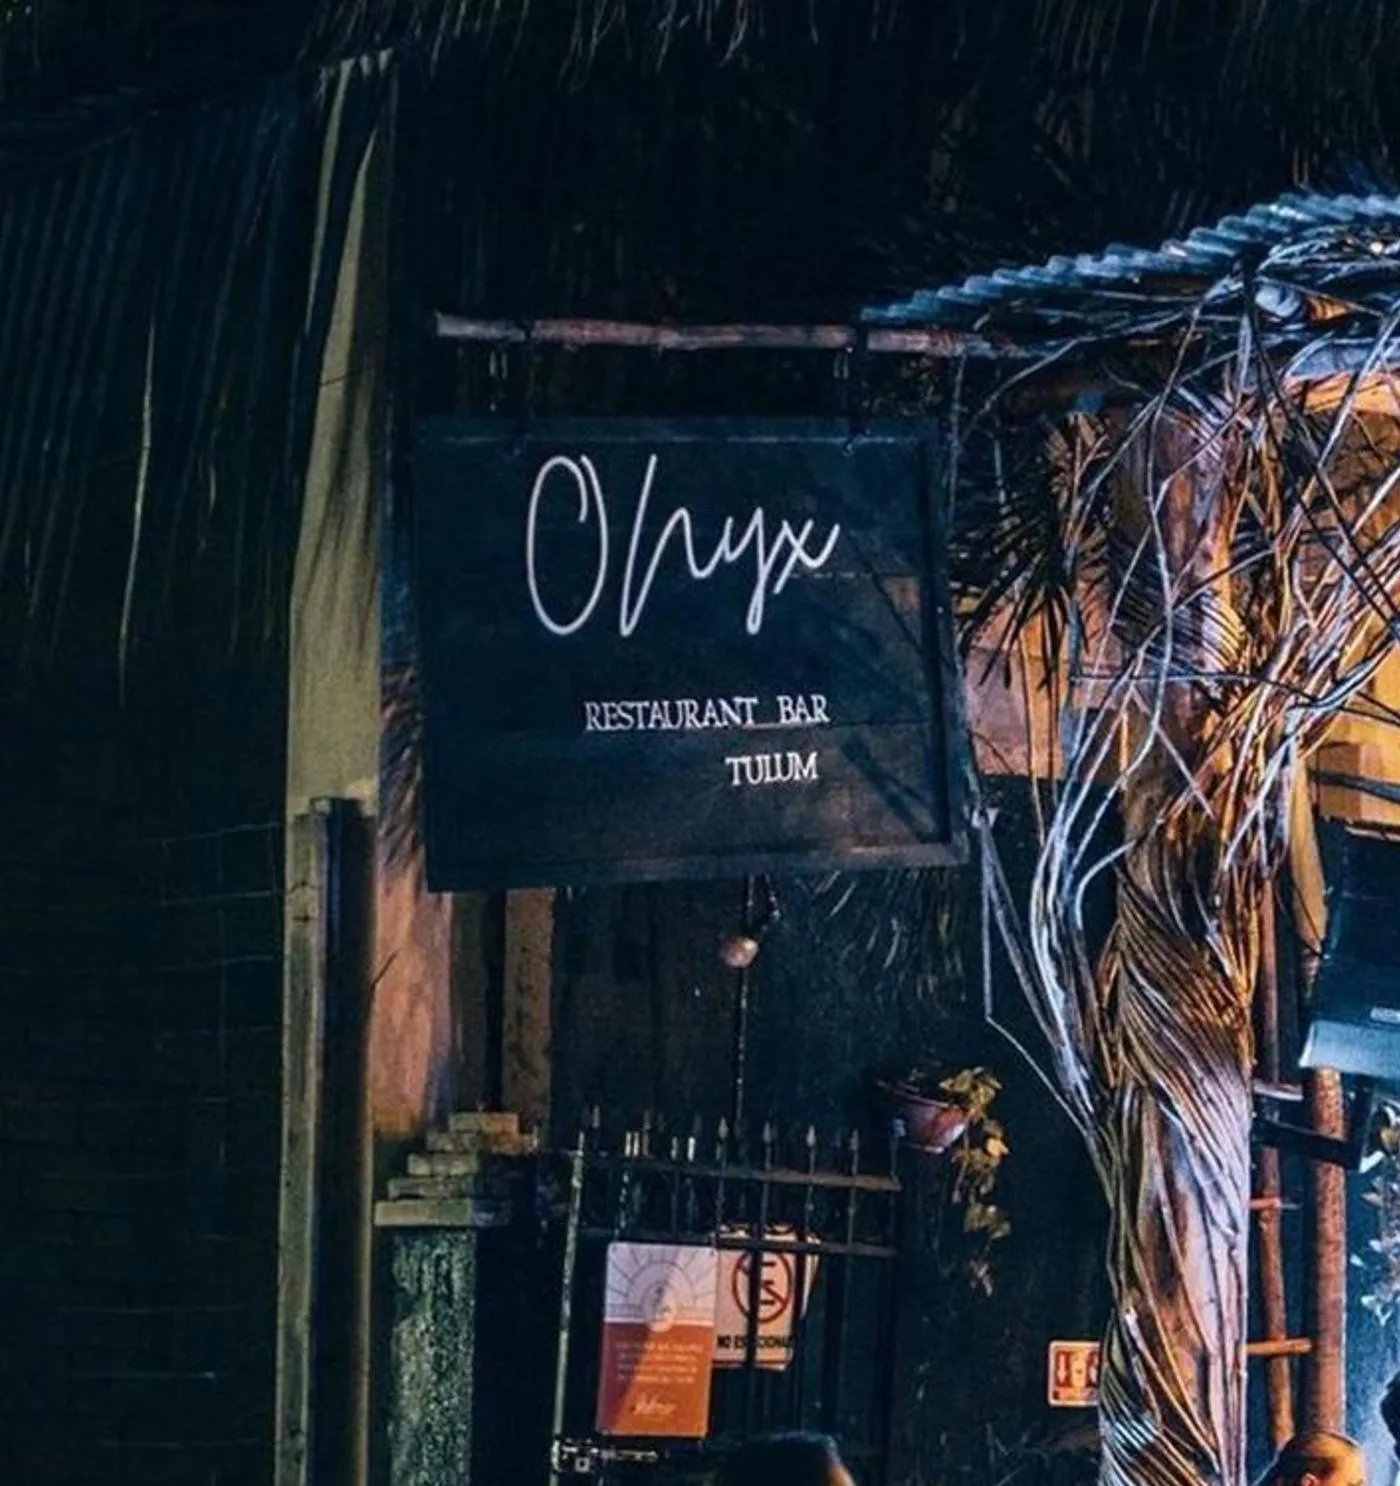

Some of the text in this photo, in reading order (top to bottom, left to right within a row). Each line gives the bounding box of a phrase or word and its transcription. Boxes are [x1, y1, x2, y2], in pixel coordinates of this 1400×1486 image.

[585, 693, 831, 731] RESTAURANT BAR
[724, 751, 819, 786] TULUM
